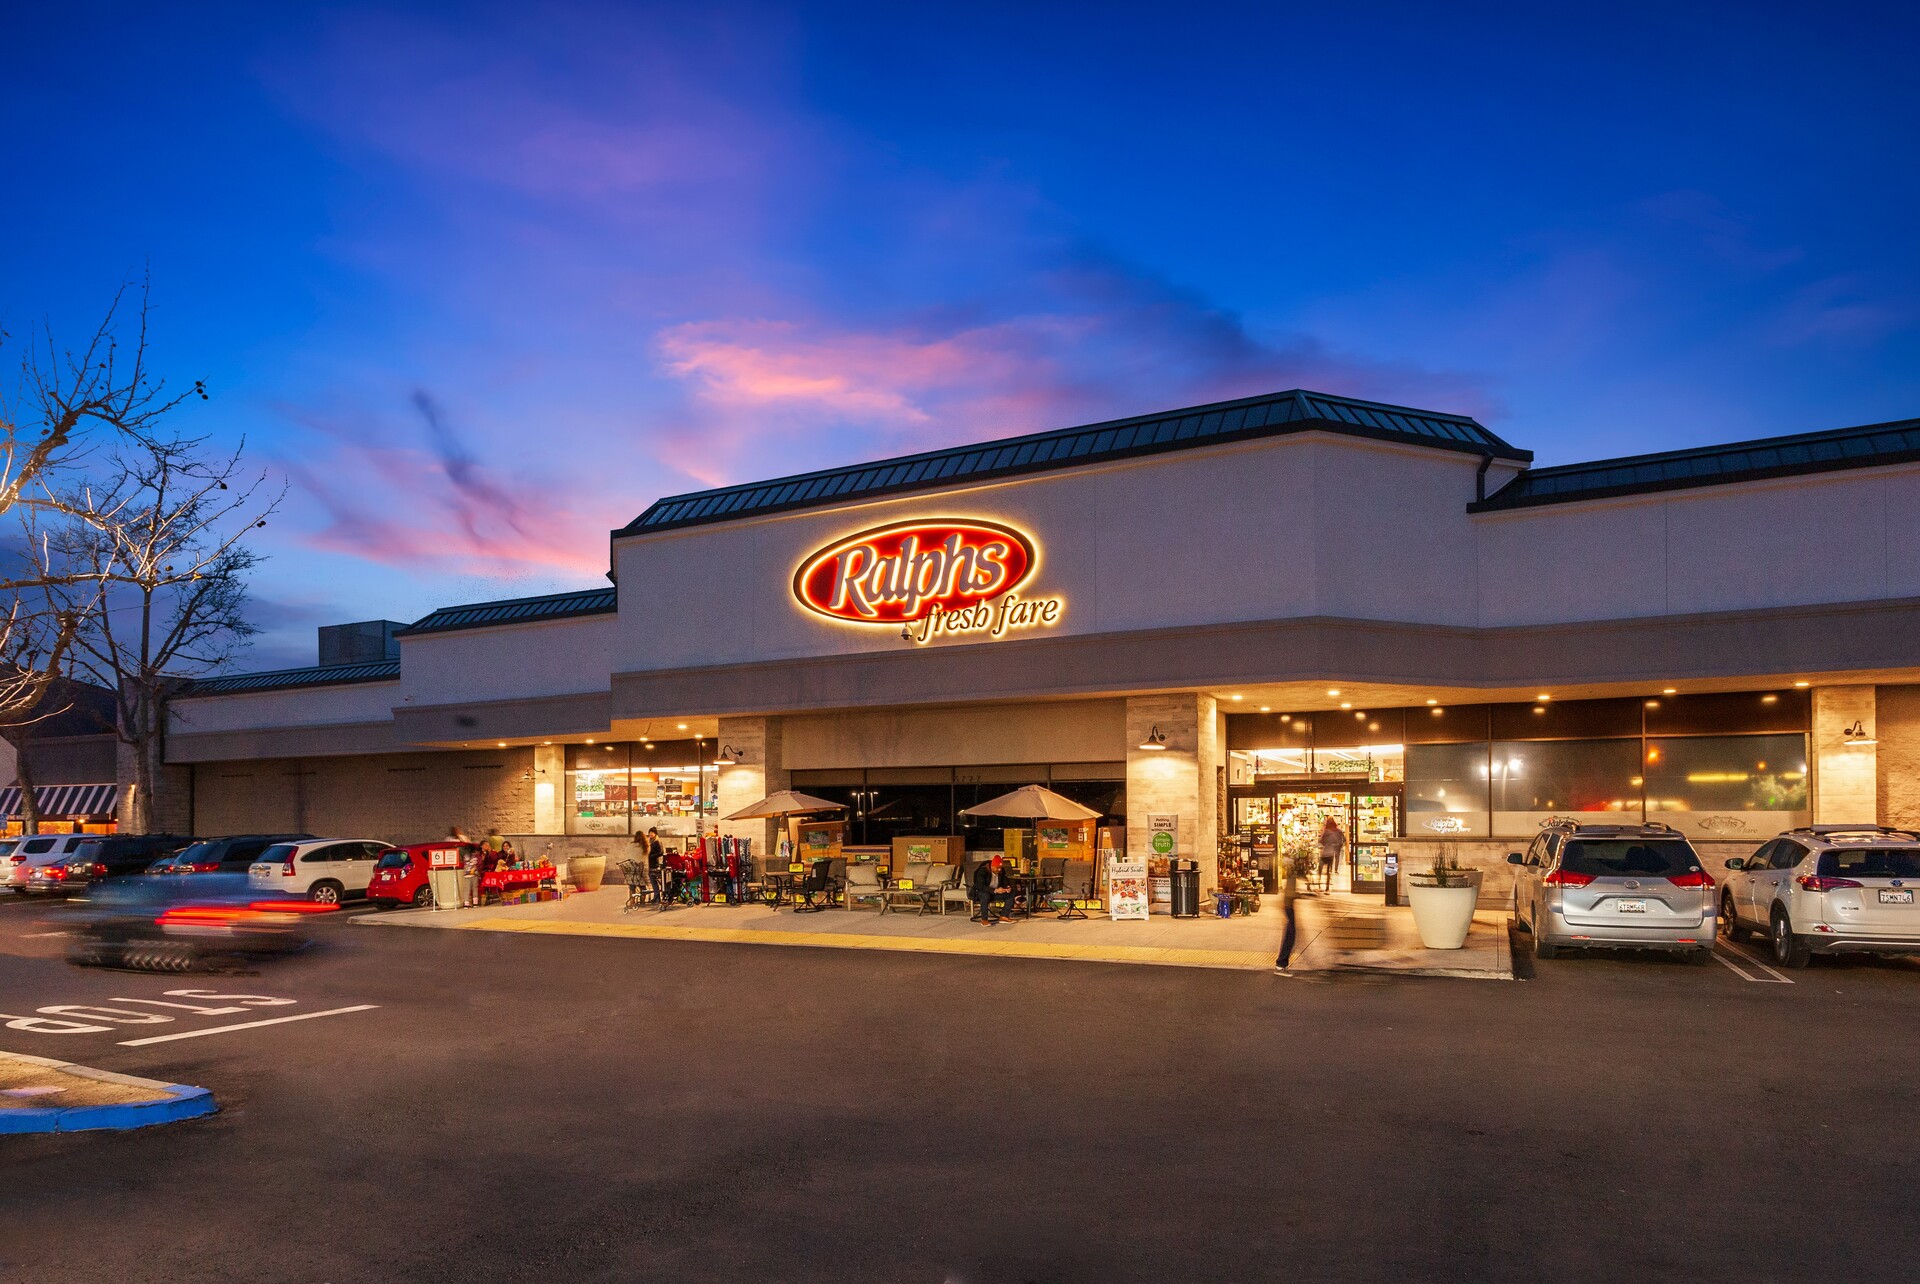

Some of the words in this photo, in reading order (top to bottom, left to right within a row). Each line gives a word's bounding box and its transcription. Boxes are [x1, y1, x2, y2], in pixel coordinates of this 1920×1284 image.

[829, 534, 1008, 616] Ralphs
[918, 599, 990, 642] fresh
[993, 595, 1058, 634] fare
[1111, 866, 1129, 874] Hybrid
[0, 990, 297, 1034] STOP
